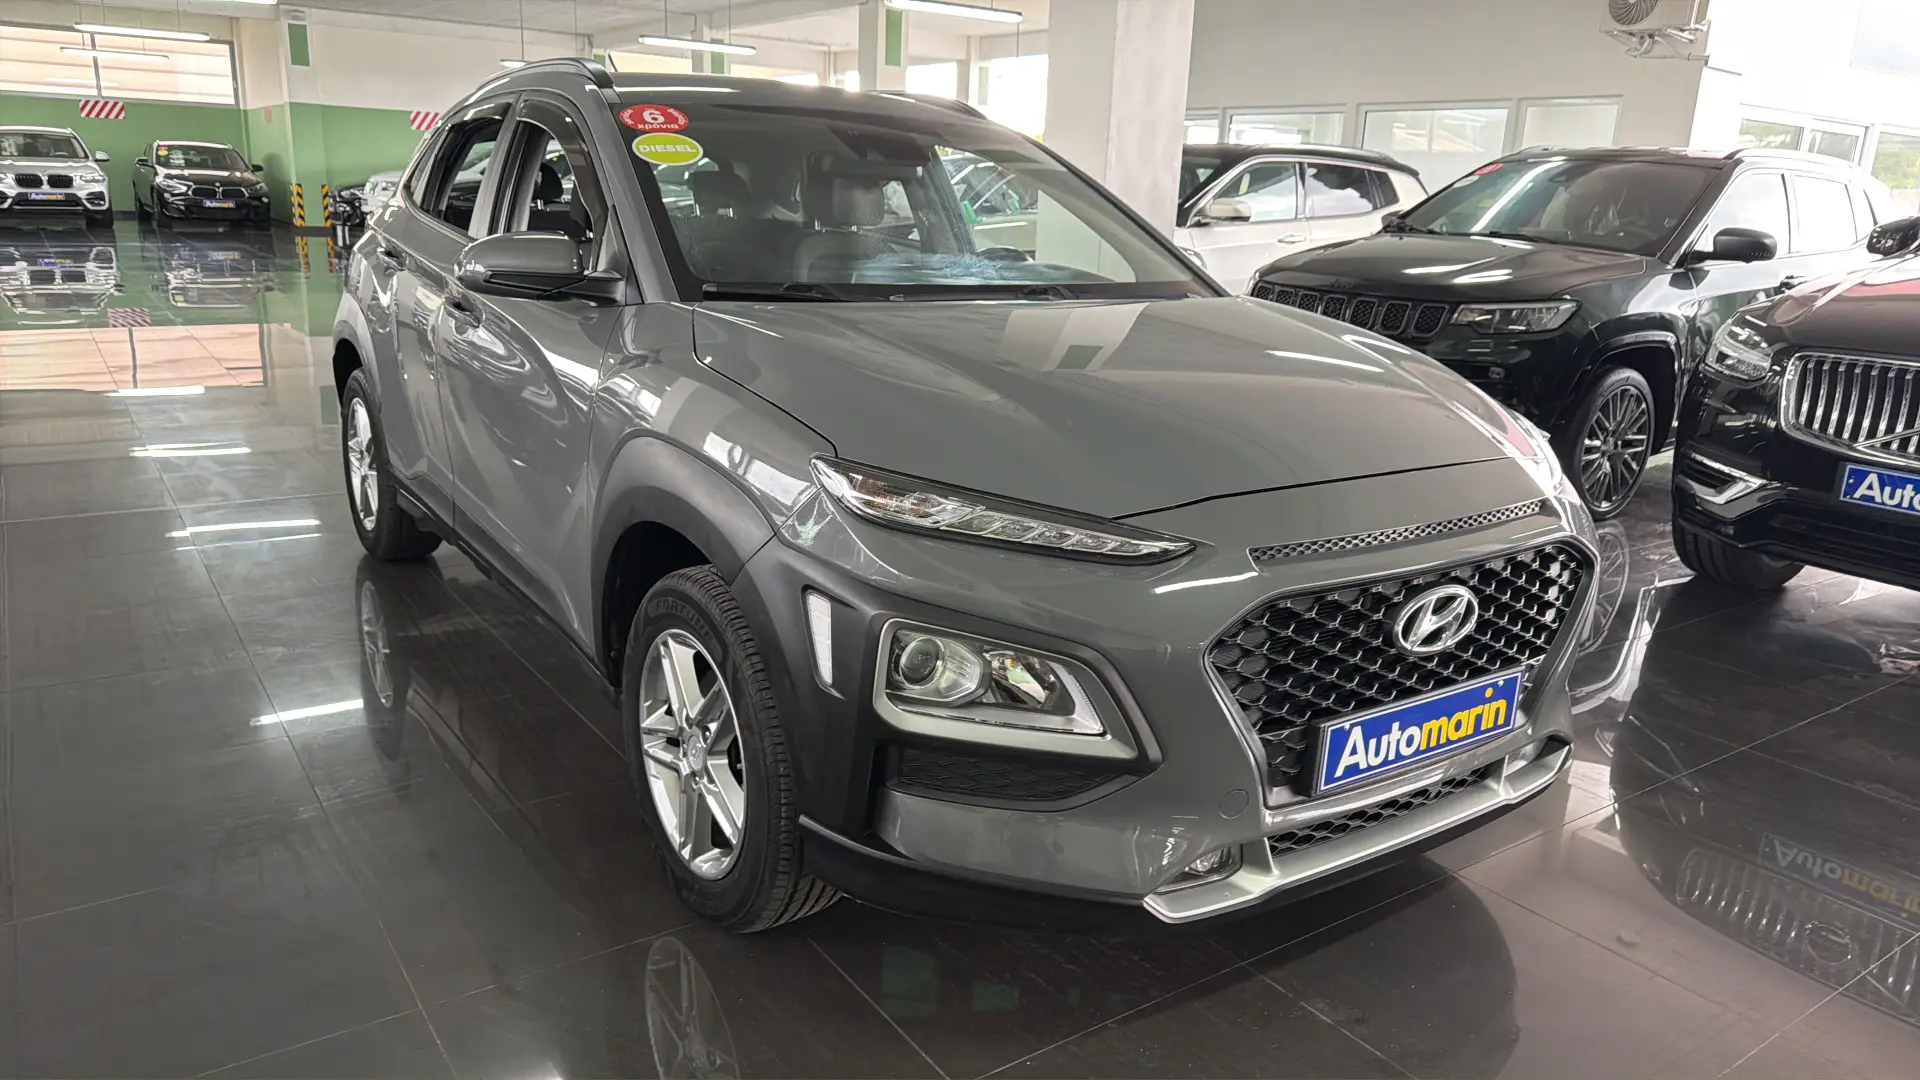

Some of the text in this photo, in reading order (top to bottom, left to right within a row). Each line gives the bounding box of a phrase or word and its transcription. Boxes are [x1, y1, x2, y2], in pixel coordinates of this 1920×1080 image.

[642, 109, 665, 124] 6
[638, 144, 697, 153] DIESEL
[1333, 687, 1507, 778] Automarin
